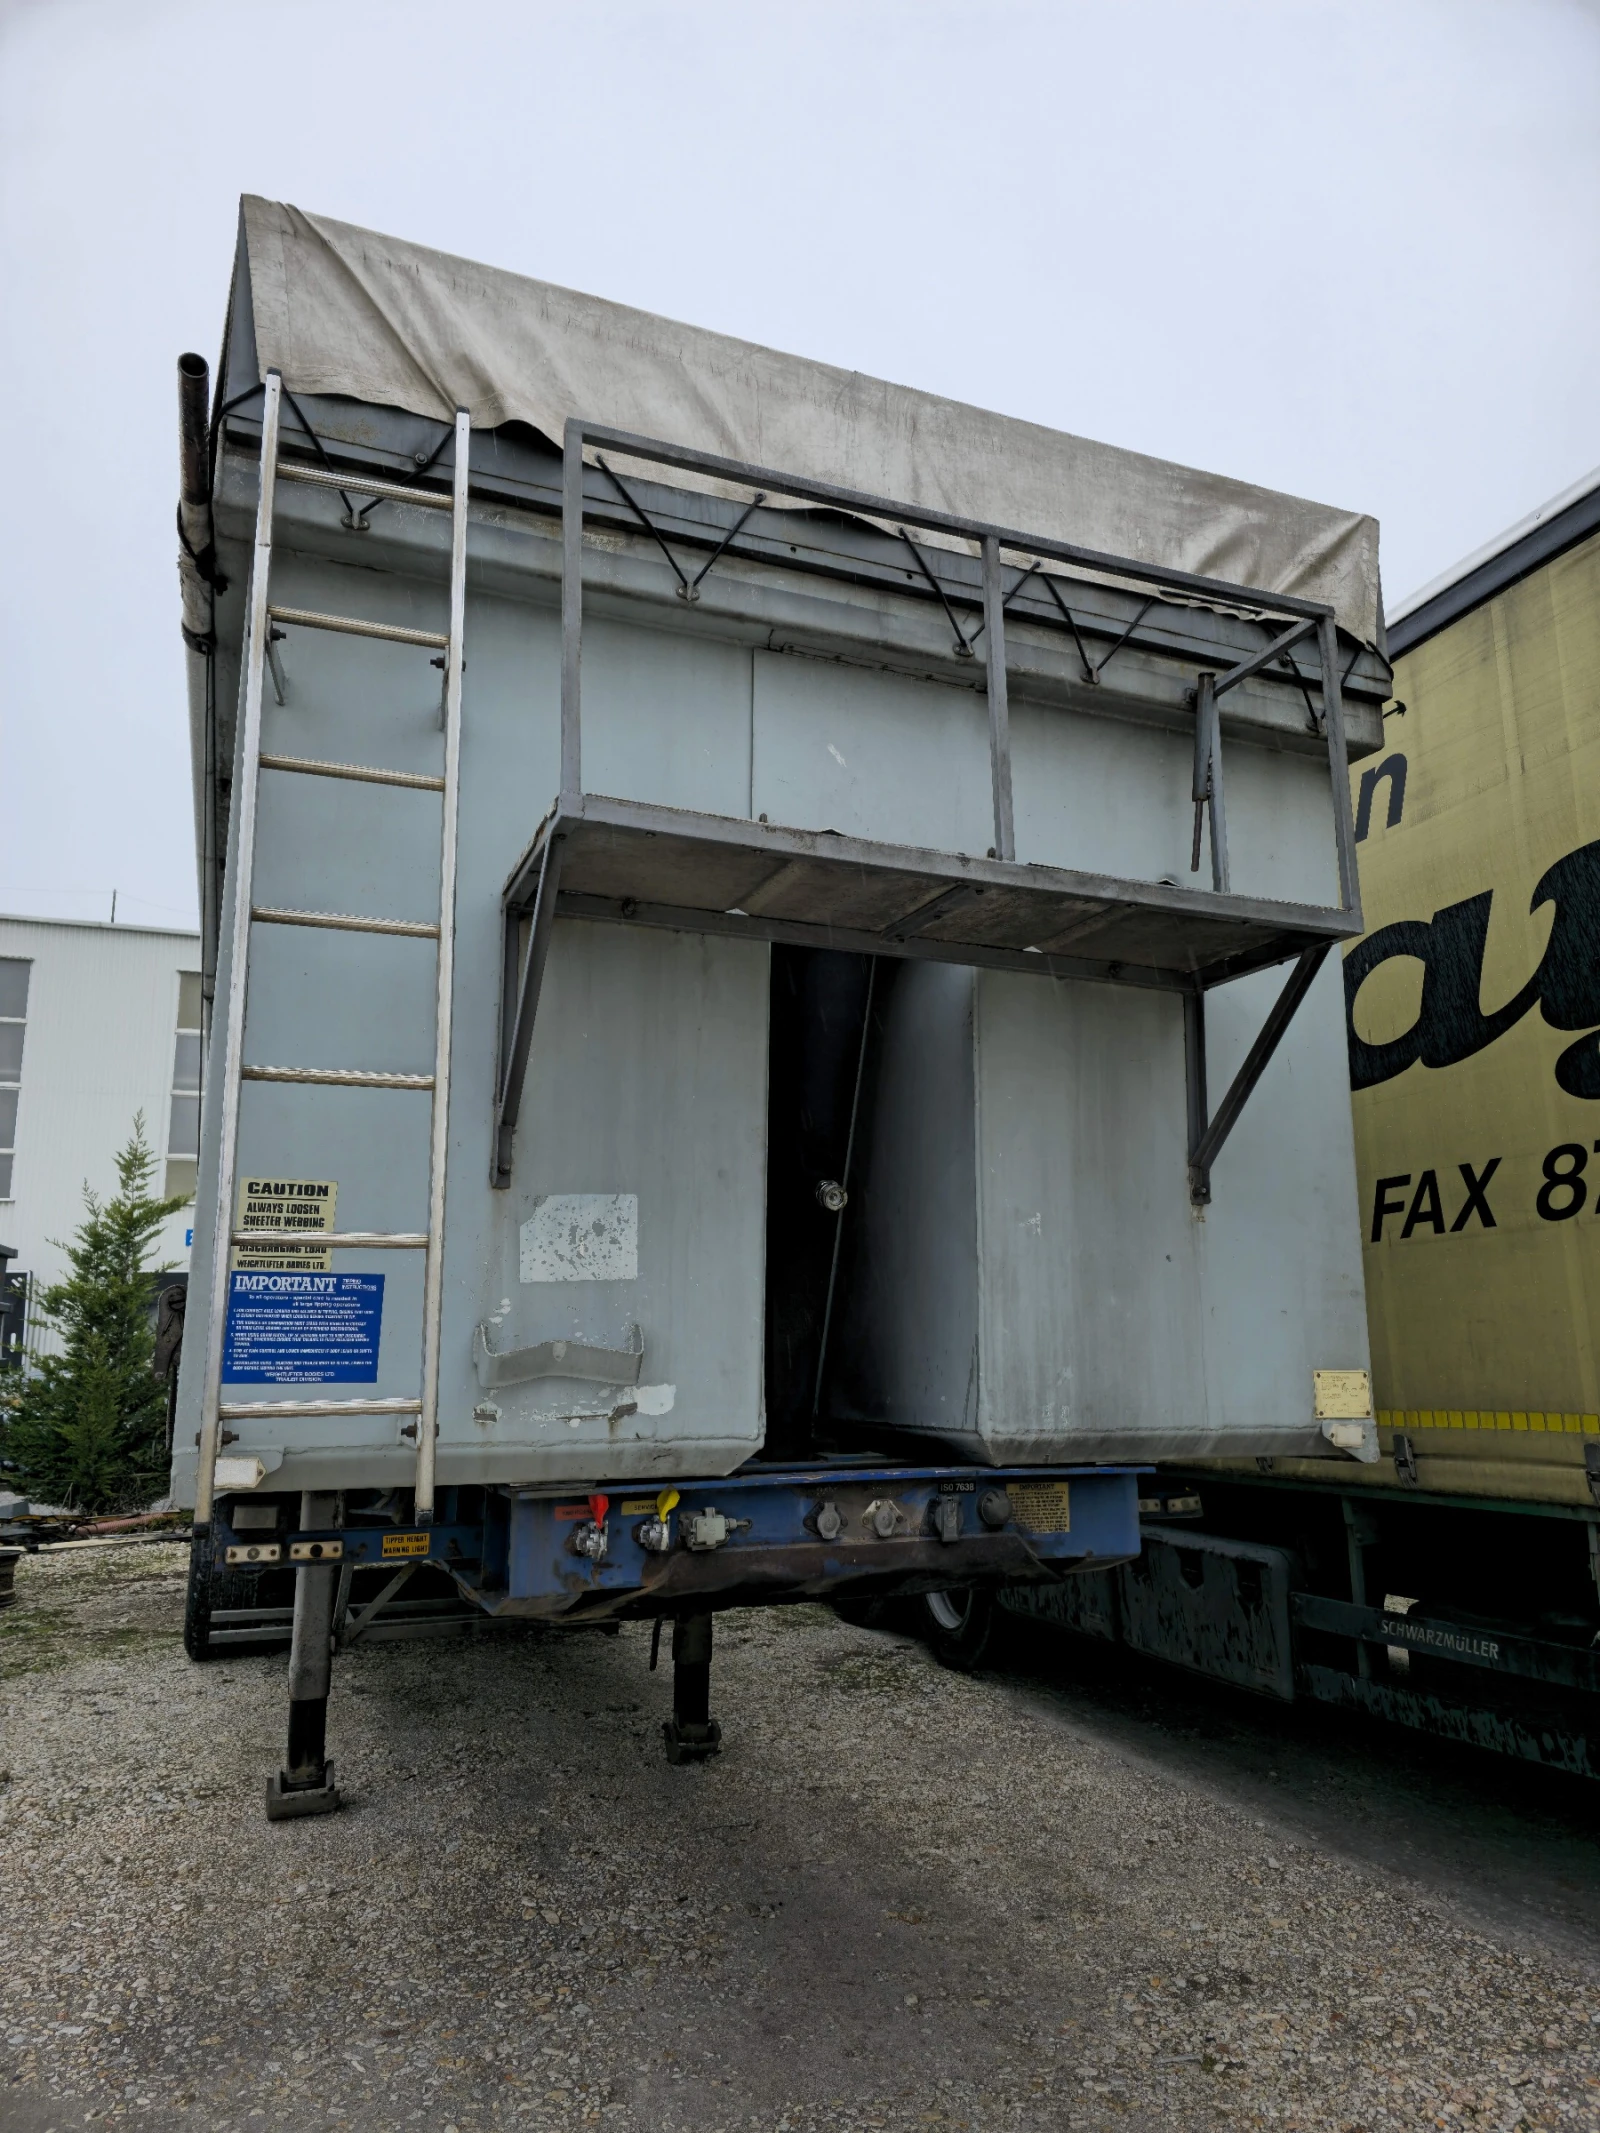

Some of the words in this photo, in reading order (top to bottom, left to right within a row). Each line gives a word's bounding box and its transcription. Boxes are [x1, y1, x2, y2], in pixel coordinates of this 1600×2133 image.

[247, 1182, 329, 1197] CAUTION
[1371, 1157, 1502, 1243] FAX
[1536, 1139, 1600, 1222] 8
[246, 1202, 284, 1214] ALWAYS
[286, 1203, 320, 1215] LOOSEN
[243, 1214, 281, 1226] SHEETER
[284, 1216, 325, 1228] WEBBING
[234, 1275, 337, 1292] IMPORTANT
[940, 1483, 954, 1492] ISO
[385, 1536, 405, 1544] TIPPER
[406, 1535, 427, 1543] HEIGHT
[383, 1546, 410, 1554] WARNING
[411, 1545, 428, 1553] LIGHT
